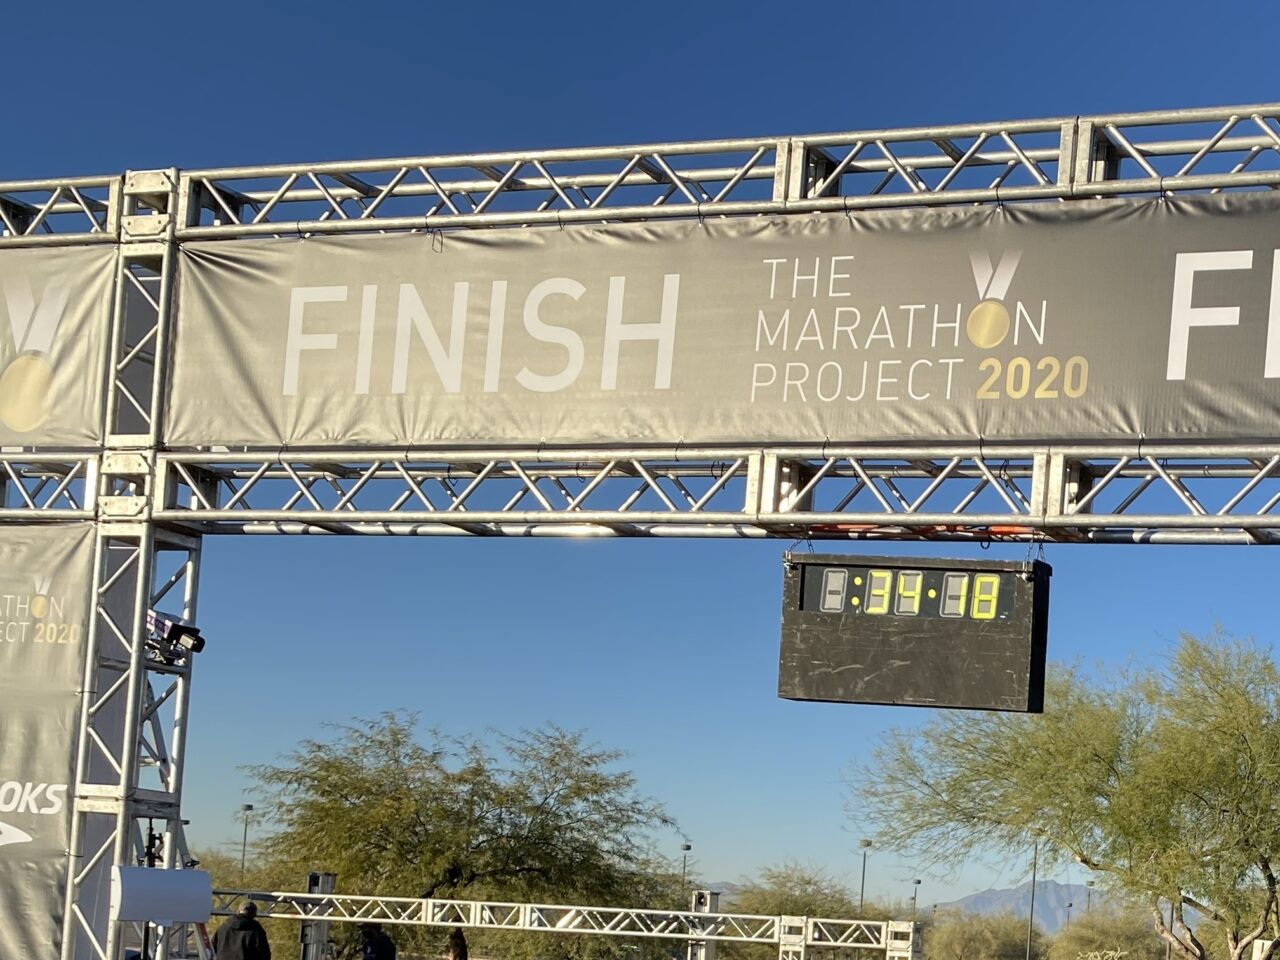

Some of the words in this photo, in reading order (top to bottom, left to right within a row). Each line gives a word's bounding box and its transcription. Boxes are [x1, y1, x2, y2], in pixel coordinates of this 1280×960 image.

[763, 256, 854, 299] THE
[282, 274, 680, 395] FINISH
[755, 300, 1047, 351] MARATHON
[751, 358, 964, 402] PROJECT
[976, 355, 1090, 400] 2020
[33, 622, 80, 644] 2020
